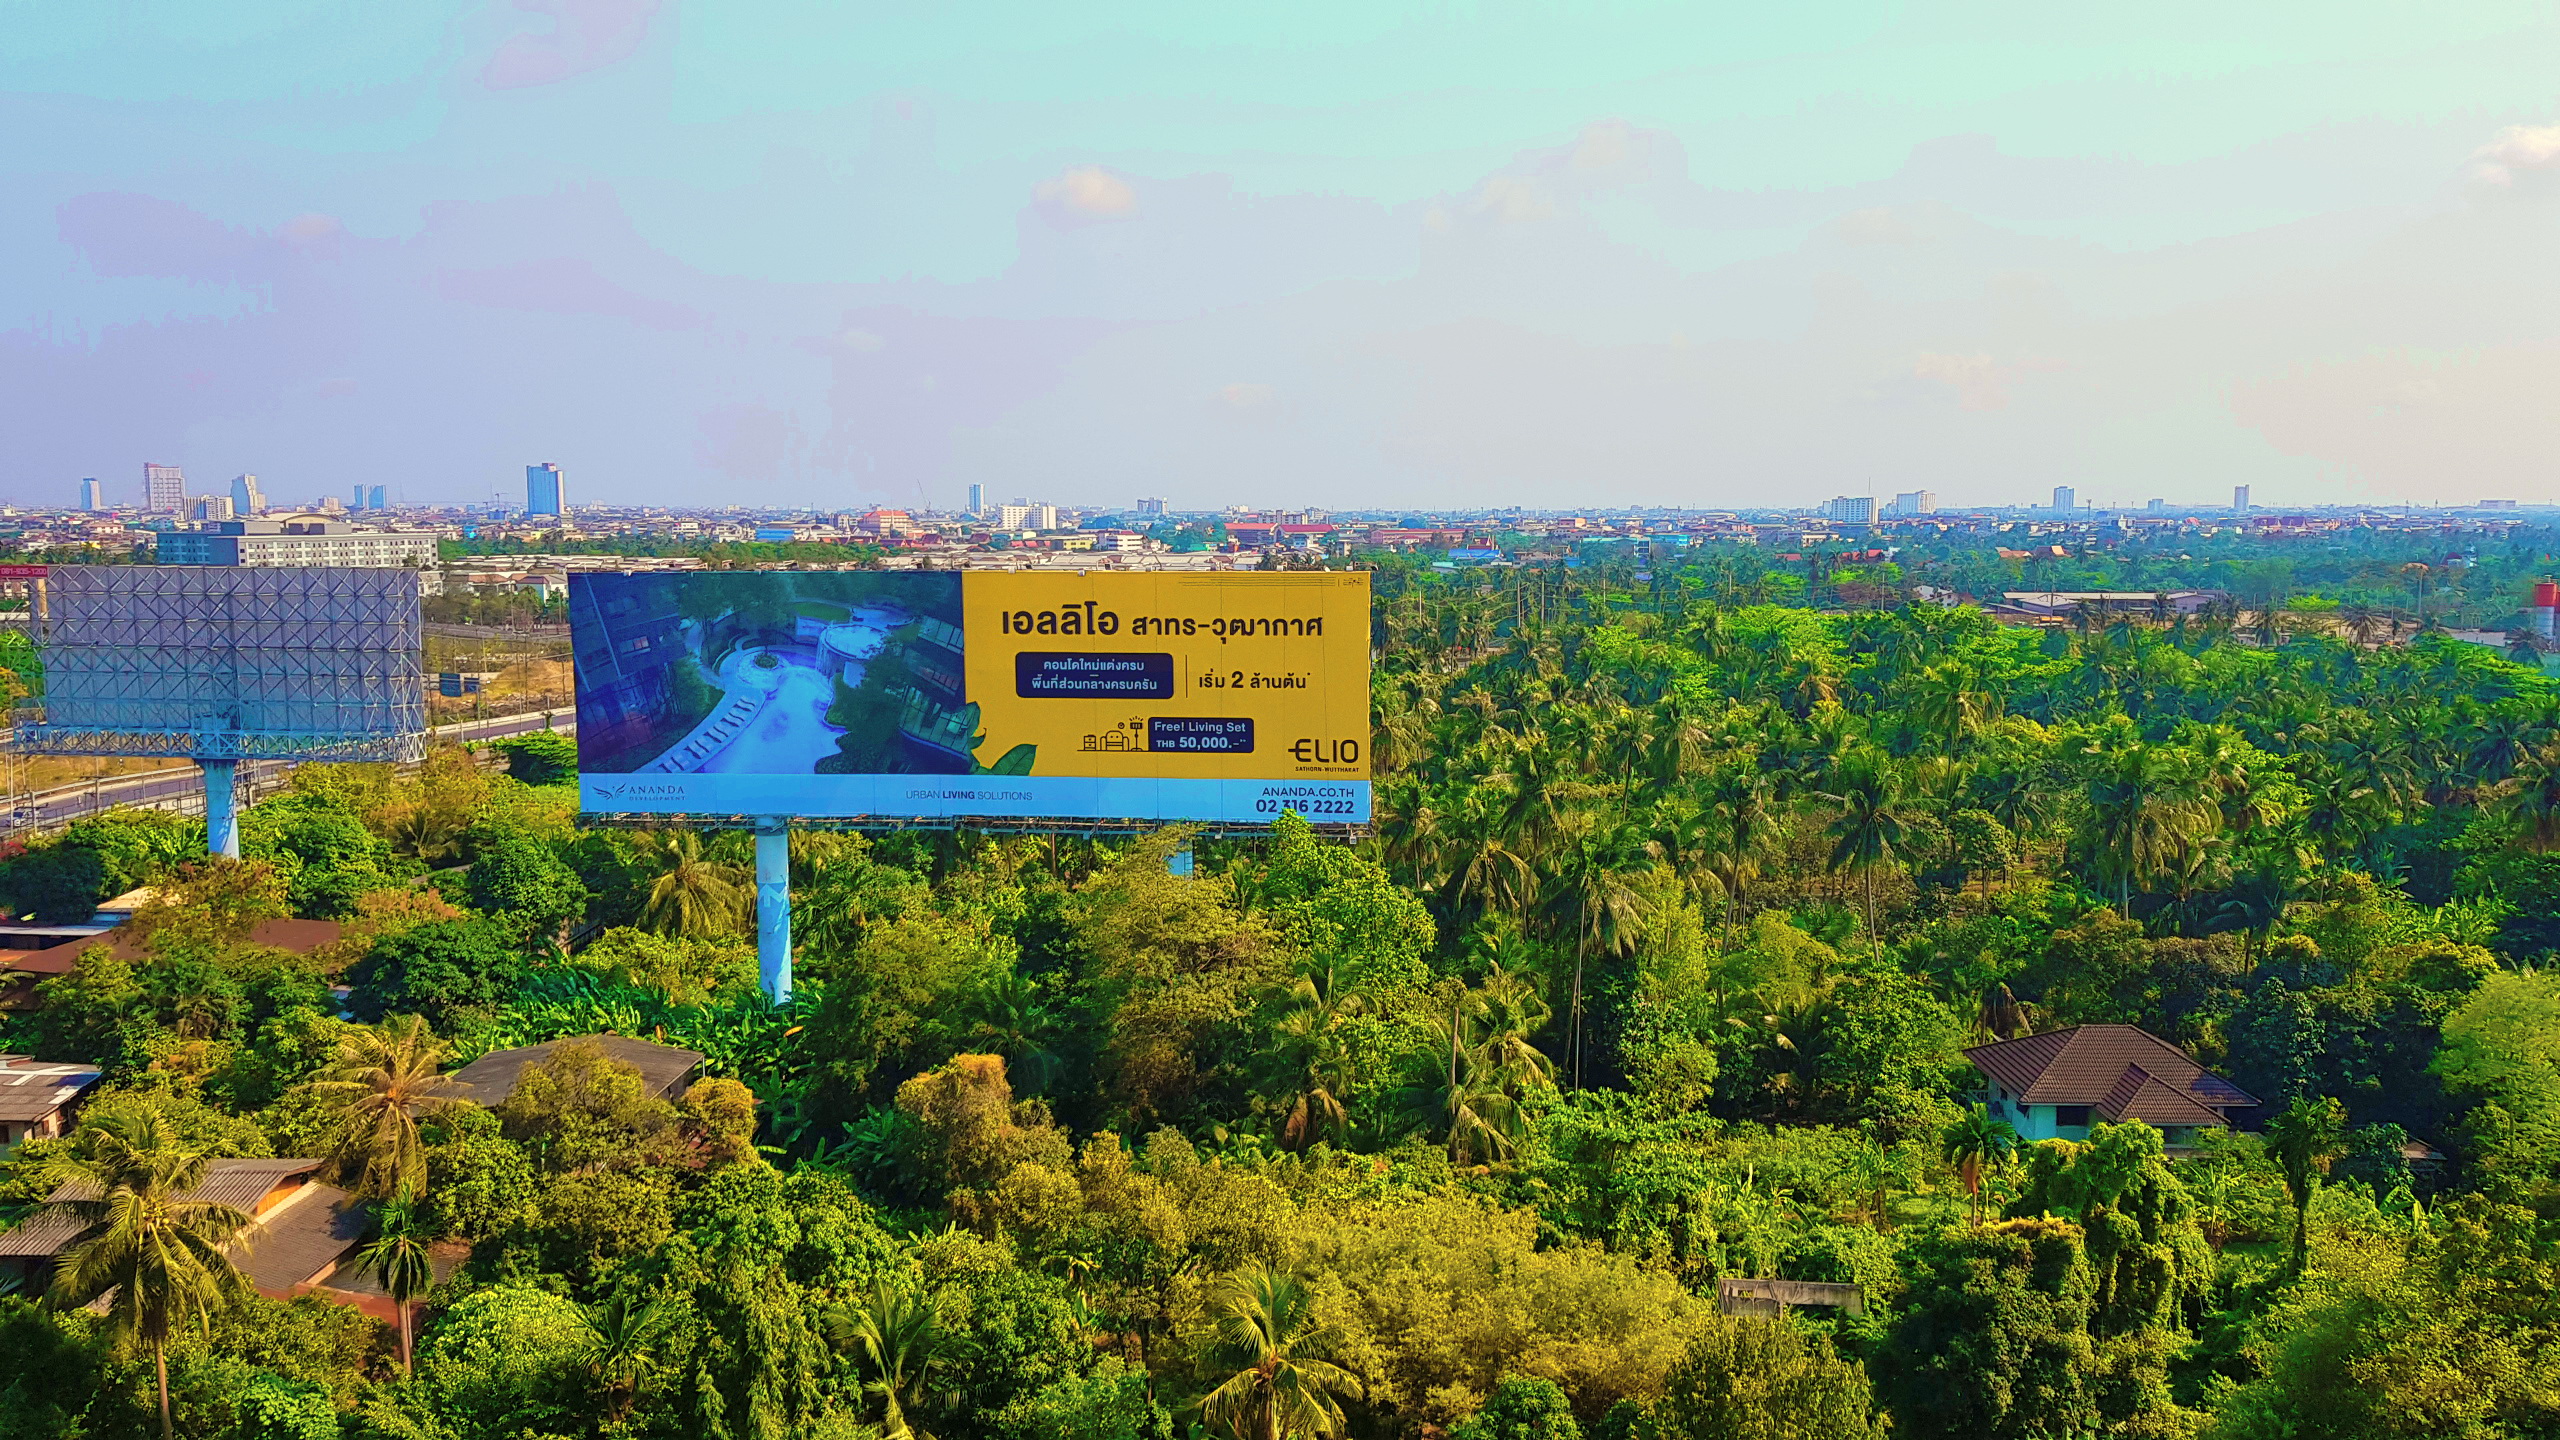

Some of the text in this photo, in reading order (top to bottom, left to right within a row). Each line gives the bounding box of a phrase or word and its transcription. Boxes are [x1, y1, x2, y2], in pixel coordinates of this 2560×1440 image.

[1002, 601, 1323, 645] เอลลิโอ สาทร-วุฒากาศ
[1043, 658, 1145, 671] คอนโดใหม่แต่งครบ
[1031, 674, 1158, 690] พื้นที่ส่วนกลางครบครัน
[1199, 668, 1225, 688] เริ่ม
[1231, 671, 1244, 689] 2
[1154, 721, 1246, 734] Free! Living Set
[1156, 739, 1175, 748] THB
[1288, 739, 1359, 763] ELIO
[629, 785, 684, 794] ANANDA
[906, 790, 1033, 800] URBAN LIVING SOLUTIONS
[1262, 787, 1354, 797] ANANDA.CO.TH
[1256, 799, 1354, 814] 02 316 2222
